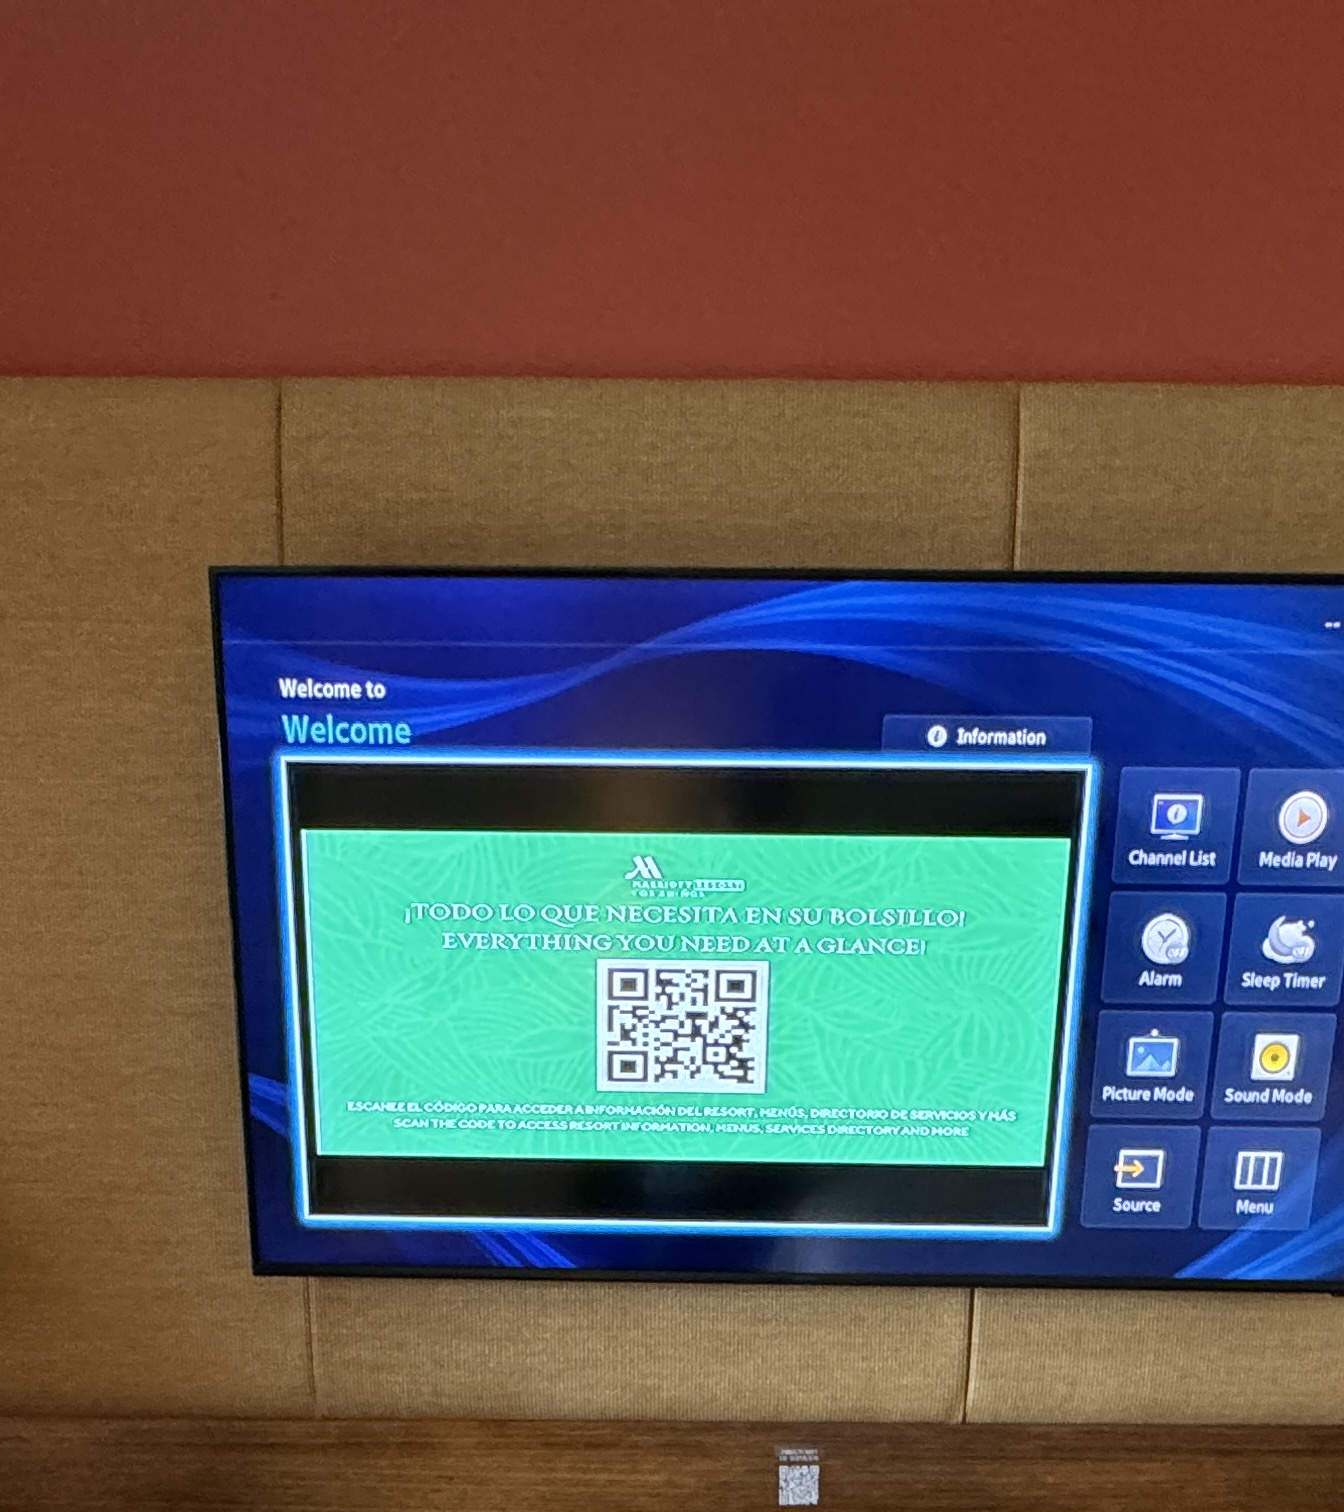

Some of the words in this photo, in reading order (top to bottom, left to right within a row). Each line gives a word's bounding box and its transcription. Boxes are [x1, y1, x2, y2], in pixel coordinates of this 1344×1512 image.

[279, 678, 362, 699] Welcome
[366, 681, 386, 699] to
[281, 713, 411, 744] Welcome
[957, 727, 1047, 747] Information
[1128, 849, 1187, 867] Channel
[1189, 850, 1217, 868] List
[1259, 851, 1303, 869] Media
[1306, 852, 1338, 872] Play
[405, 902, 494, 923] ¡TODO
[499, 903, 536, 922] LO
[541, 904, 600, 927] QUE
[607, 905, 738, 924] NECESITA
[745, 906, 782, 924] EN
[788, 907, 824, 925] SU
[441, 932, 613, 951] EVERYTHING
[616, 934, 675, 951] YOU
[680, 935, 751, 952] NEED
[755, 937, 790, 953] AT
[793, 938, 812, 954] A
[1138, 970, 1182, 987] Alarm
[1241, 972, 1281, 991] Sleep
[1283, 973, 1327, 989] Timer
[1102, 1085, 1152, 1102] Picture
[1153, 1086, 1195, 1103] Mode
[1224, 1087, 1271, 1104] Sound
[1271, 1089, 1313, 1105] Mode
[407, 1102, 422, 1113] EL
[423, 1101, 477, 1114] CÓDIGO
[479, 1104, 512, 1114] PARA
[513, 1104, 573, 1115] ACCEDER
[574, 1105, 584, 1115] A
[677, 1106, 702, 1117] DEL
[810, 1109, 888, 1120] DIRECTORIO
[890, 1109, 906, 1120] DE
[909, 1110, 977, 1121] SERVICIOS
[978, 1111, 988, 1121] Y
[393, 1118, 430, 1129] SCAN
[431, 1119, 456, 1129] THE
[458, 1119, 496, 1129] CODE
[498, 1120, 516, 1130] TO
[517, 1120, 568, 1130] ACCESS
[569, 1121, 619, 1131] RESORT
[765, 1124, 826, 1135] SERVICES
[827, 1125, 900, 1136] DIRECTORY
[900, 1126, 931, 1136] AND
[931, 1127, 969, 1137] MORE
[1112, 1198, 1161, 1213] Source
[1235, 1200, 1274, 1215] Menu
